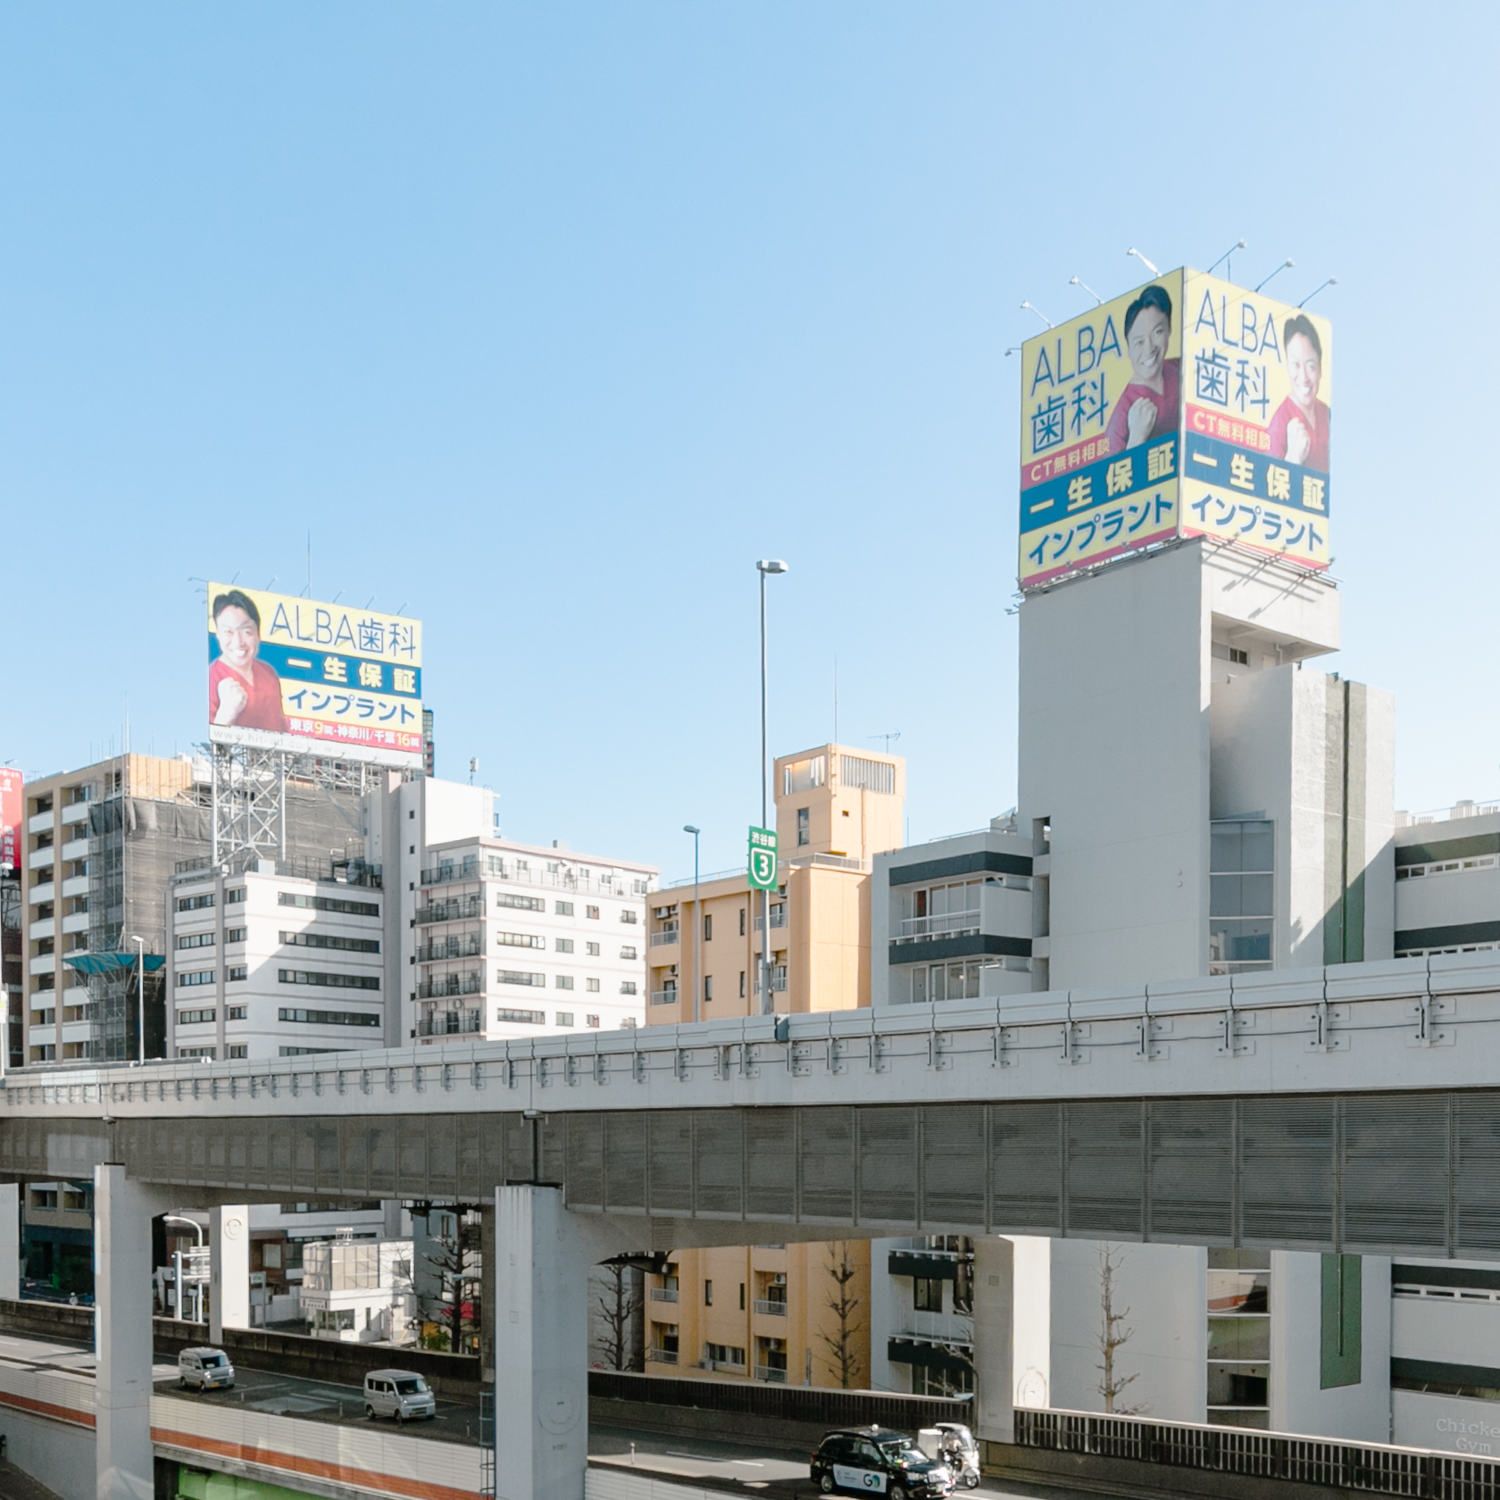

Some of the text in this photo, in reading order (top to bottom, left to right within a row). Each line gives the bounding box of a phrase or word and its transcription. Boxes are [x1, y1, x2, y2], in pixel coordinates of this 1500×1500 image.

[1195, 289, 1282, 363] ALBA
[1031, 314, 1122, 397] ALBA
[1195, 347, 1270, 420] 歯科
[1031, 372, 1109, 454] 歯科
[1194, 411, 1271, 451] CT無料相談
[1029, 441, 1175, 514] 一生保証
[1031, 437, 1110, 482] CT無料相談
[1192, 453, 1326, 512] 一生保証
[1029, 493, 1174, 565] インプラント
[1191, 494, 1324, 551] インプラント
[269, 602, 417, 659] ALBA歯科
[287, 656, 417, 694] 一生保証
[288, 689, 416, 724] インプラント
[758, 854, 769, 877] 3
[1455, 1437, 1491, 1454] Gym
